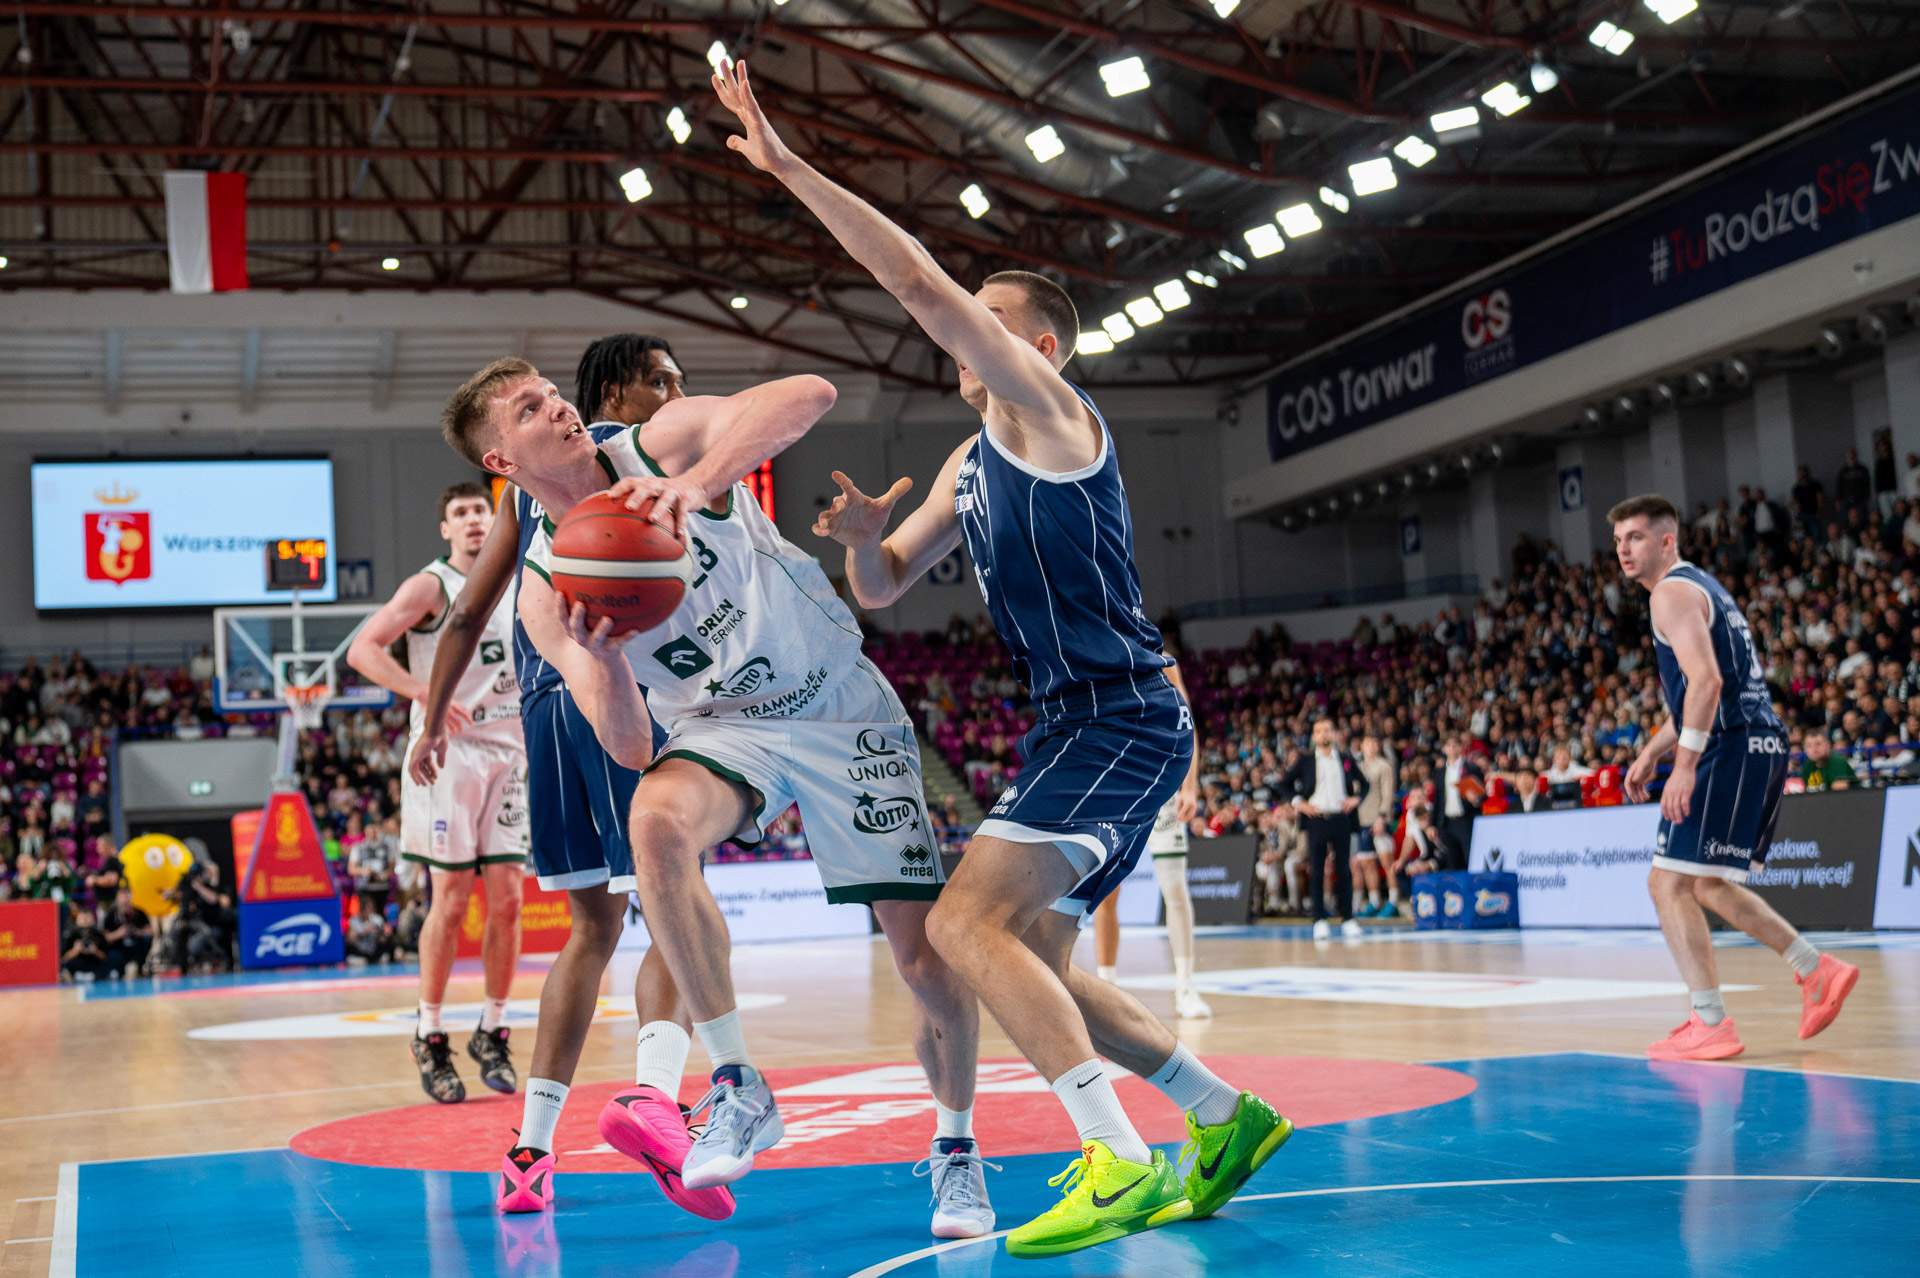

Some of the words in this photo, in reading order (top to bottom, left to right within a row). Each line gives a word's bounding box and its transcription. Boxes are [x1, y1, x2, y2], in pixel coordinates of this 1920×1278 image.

[1277, 378, 1335, 440] COS
[1338, 344, 1437, 416] Torwar
[163, 533, 270, 553] Warszaw
[576, 592, 641, 607] molten
[740, 670, 816, 718] TRAMWAJE
[768, 666, 829, 717] ZAWSKIE
[847, 761, 909, 782] UNIQA
[863, 803, 910, 828] LOTTO
[988, 804, 1009, 815] rrea
[1516, 846, 1653, 868] Górnośląsko-Zagłębiowsk
[1765, 838, 1820, 862] połowo.
[900, 866, 934, 877] errea
[1802, 862, 1854, 888] więcej!
[255, 932, 317, 958] PGE
[532, 1089, 561, 1103] JAKO
